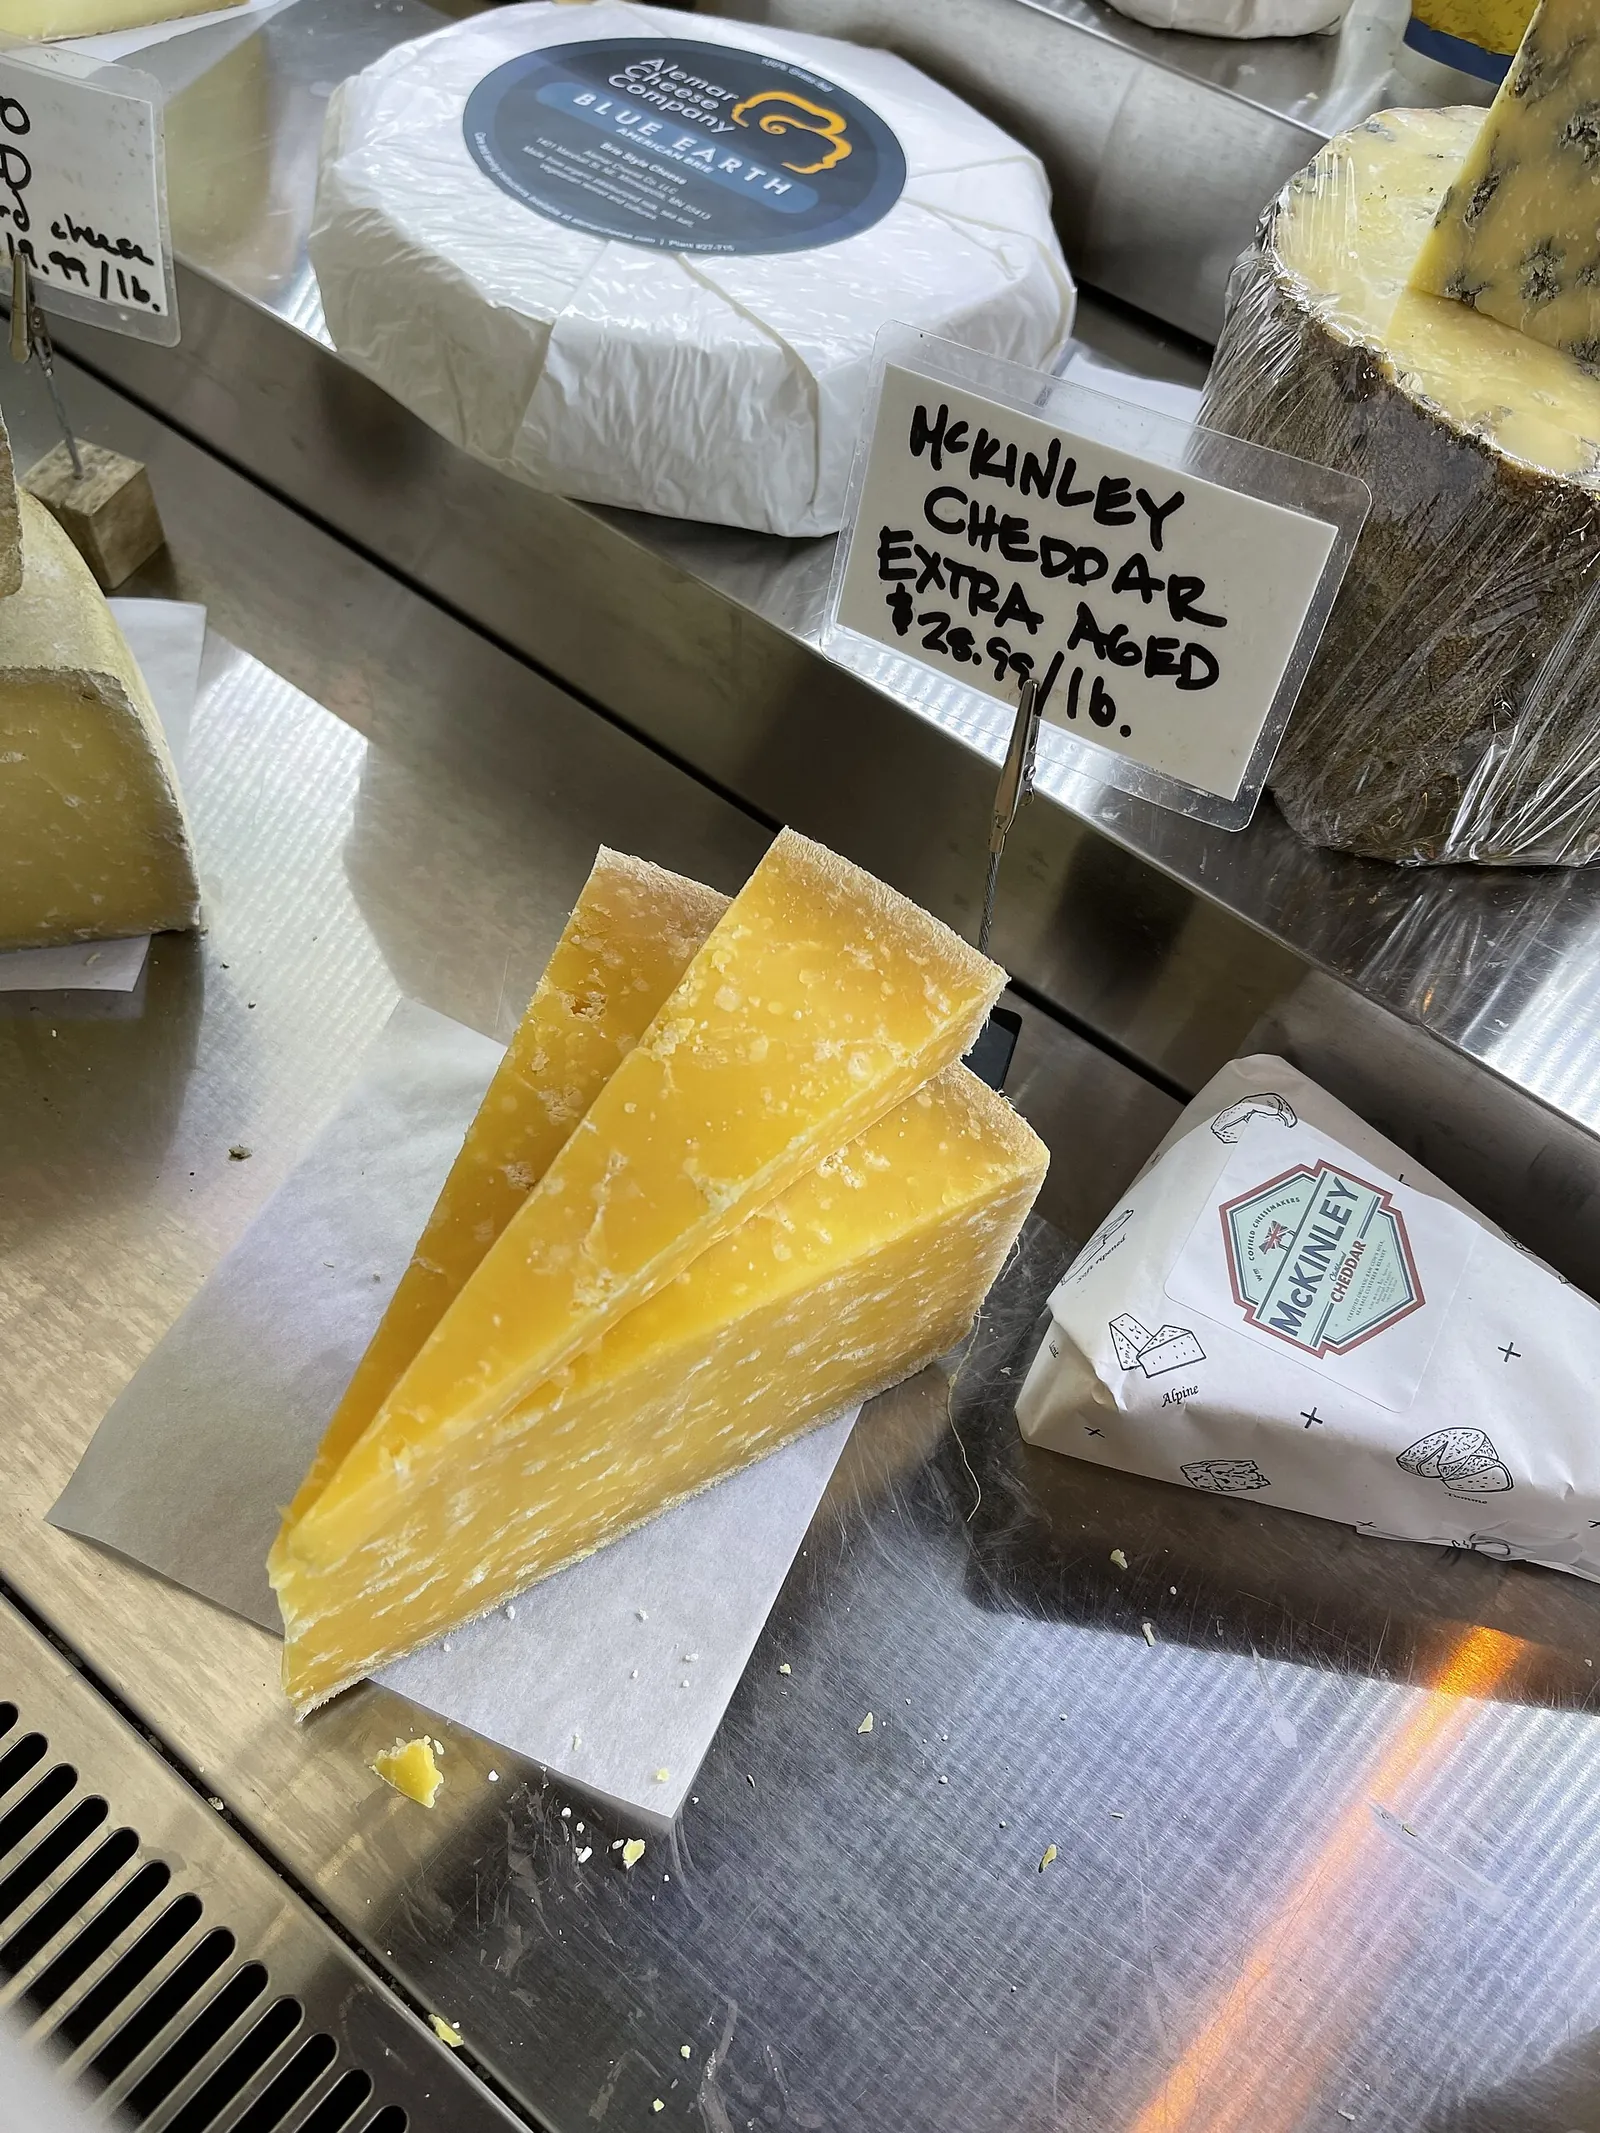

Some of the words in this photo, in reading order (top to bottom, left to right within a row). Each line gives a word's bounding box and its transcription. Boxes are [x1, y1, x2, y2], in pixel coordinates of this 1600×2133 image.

[608, 73, 735, 133] Company
[624, 64, 719, 110] Cheese
[640, 58, 739, 101] Alemar
[573, 93, 663, 136] BLUE
[672, 136, 792, 195] EARTH
[616, 127, 684, 160] AMERICAN
[877, 526, 1044, 635] EXTRA
[924, 486, 1227, 628] CHEDDAR
[1067, 601, 1220, 691] AGED
[1268, 1176, 1359, 1337] McKINLEY
[1330, 1240, 1367, 1303] CHEDDAR
[1162, 1385, 1199, 1408] Alpine
